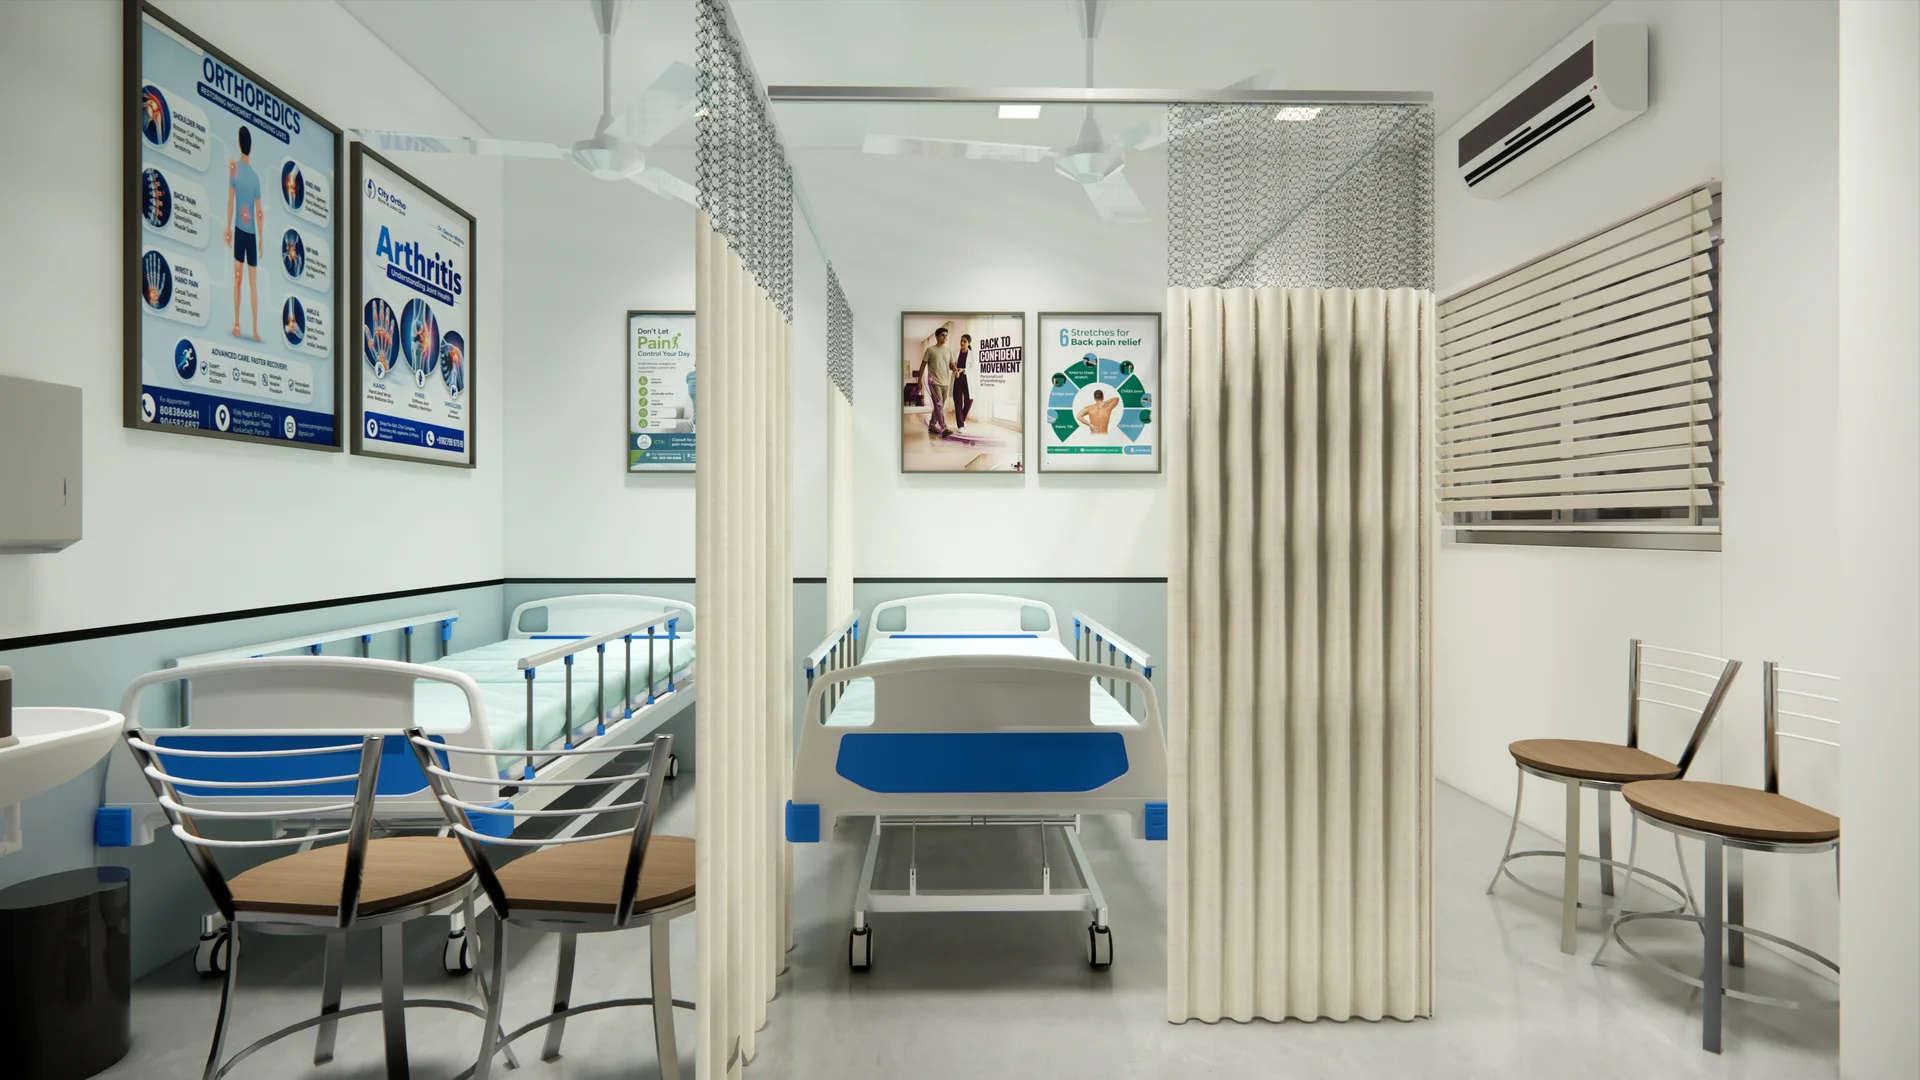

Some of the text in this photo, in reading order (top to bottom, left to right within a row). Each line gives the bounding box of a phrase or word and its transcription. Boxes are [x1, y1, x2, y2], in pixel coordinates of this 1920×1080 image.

[203, 57, 300, 134] ORTHOPEDICS
[201, 87, 227, 107] RESTORING
[253, 117, 275, 134] IMPROVING
[173, 111, 206, 133] SHOULDER PAIN
[174, 191, 196, 206] BACK PAIN
[378, 187, 406, 210] City Ortho
[376, 225, 462, 295] Arthritis
[175, 265, 188, 275] WRIST
[175, 275, 198, 288] HAND PAIN
[391, 268, 451, 302] Understanding Joint Health
[638, 335, 670, 349] Pain
[980, 336, 1010, 349] BACK TO
[1060, 328, 1129, 347] 6 Stretches for
[1071, 338, 1141, 347] Back pain relief
[211, 348, 237, 360] ADVANCED
[237, 354, 250, 362] CARE.
[251, 357, 266, 366] FASTER
[980, 348, 1020, 361] CONFIDENT
[209, 361, 219, 370] Expert
[980, 362, 1021, 373] MOVEMENT
[209, 369, 226, 379] Orthopedic
[160, 405, 199, 419] 8083866841
